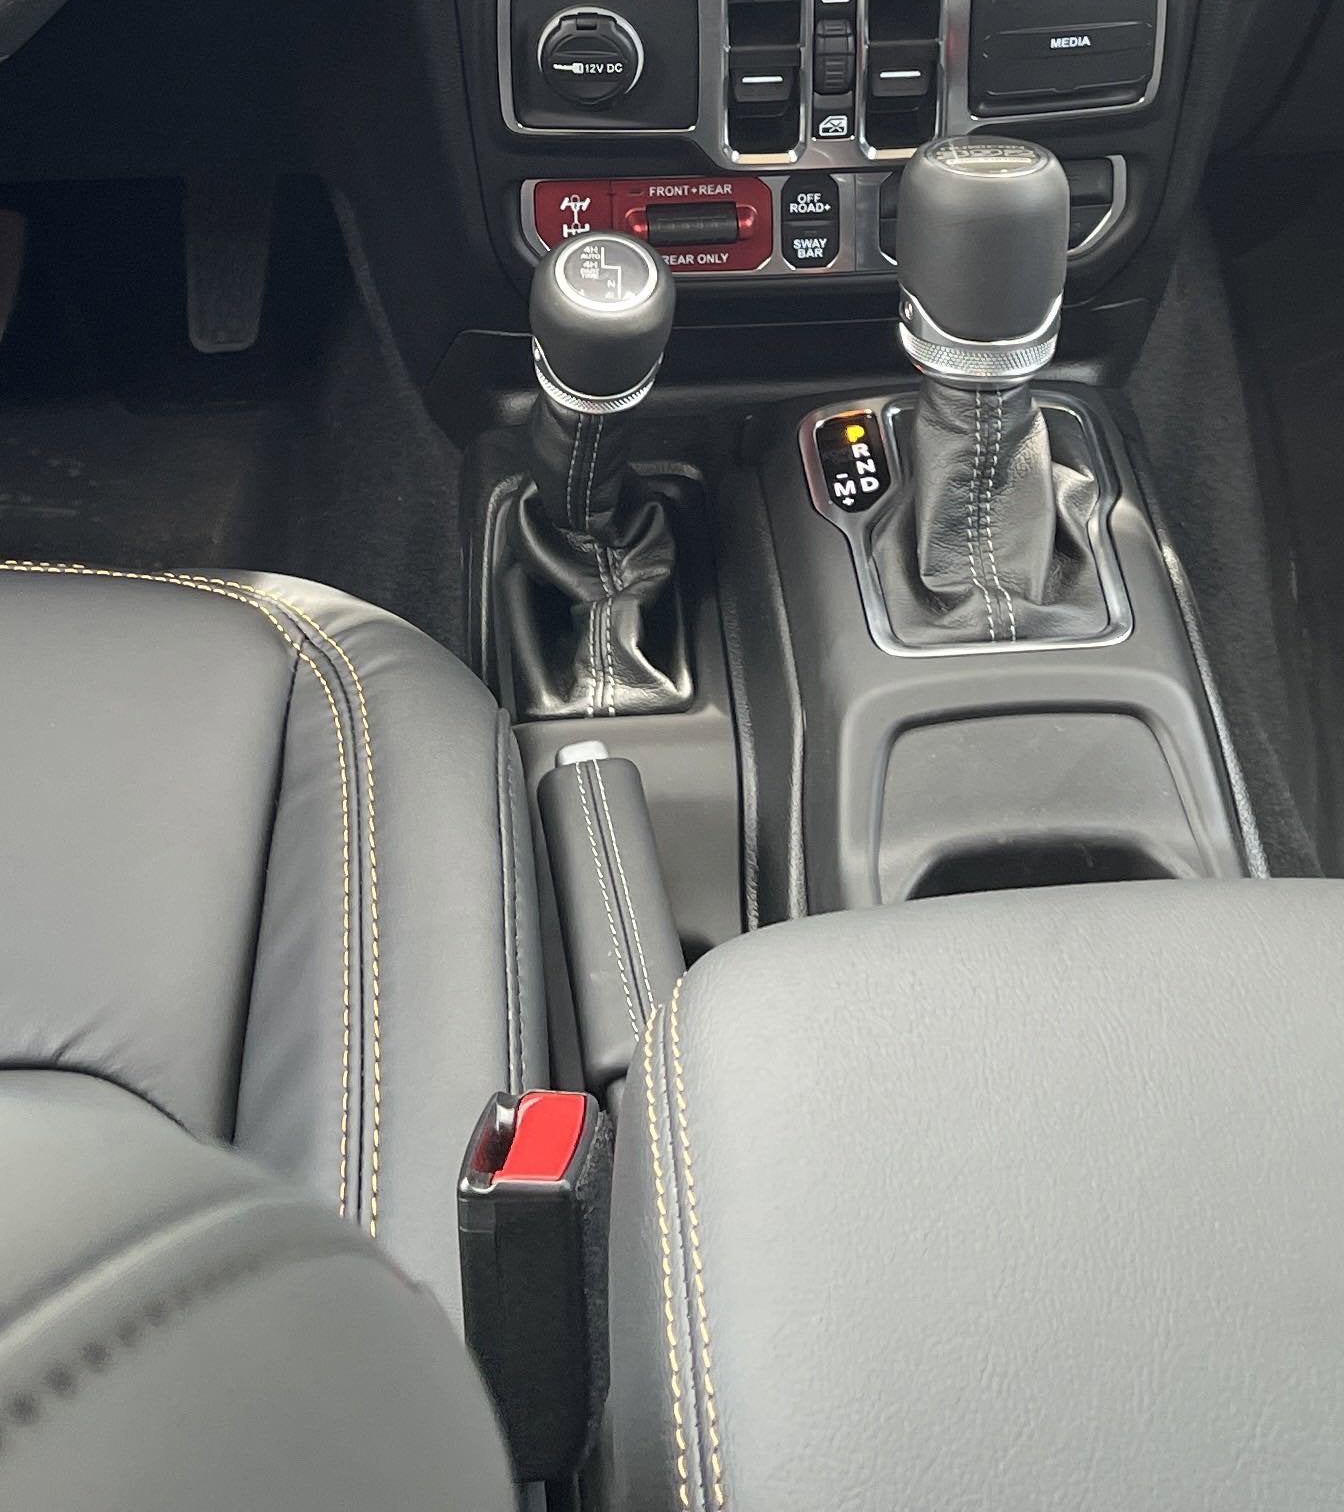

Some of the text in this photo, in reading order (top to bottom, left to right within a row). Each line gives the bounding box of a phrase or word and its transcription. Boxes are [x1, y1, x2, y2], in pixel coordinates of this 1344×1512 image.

[1050, 35, 1092, 49] MEDIA
[585, 63, 623, 74] 12V DC
[796, 193, 822, 204] OFF
[793, 238, 828, 250] SWAY
[697, 253, 729, 265] ONLY
[797, 248, 824, 259] BAR
[846, 424, 865, 443] P
[851, 443, 871, 459] R
[856, 459, 876, 475] N
[833, 479, 857, 497] M
[859, 476, 880, 492] D
